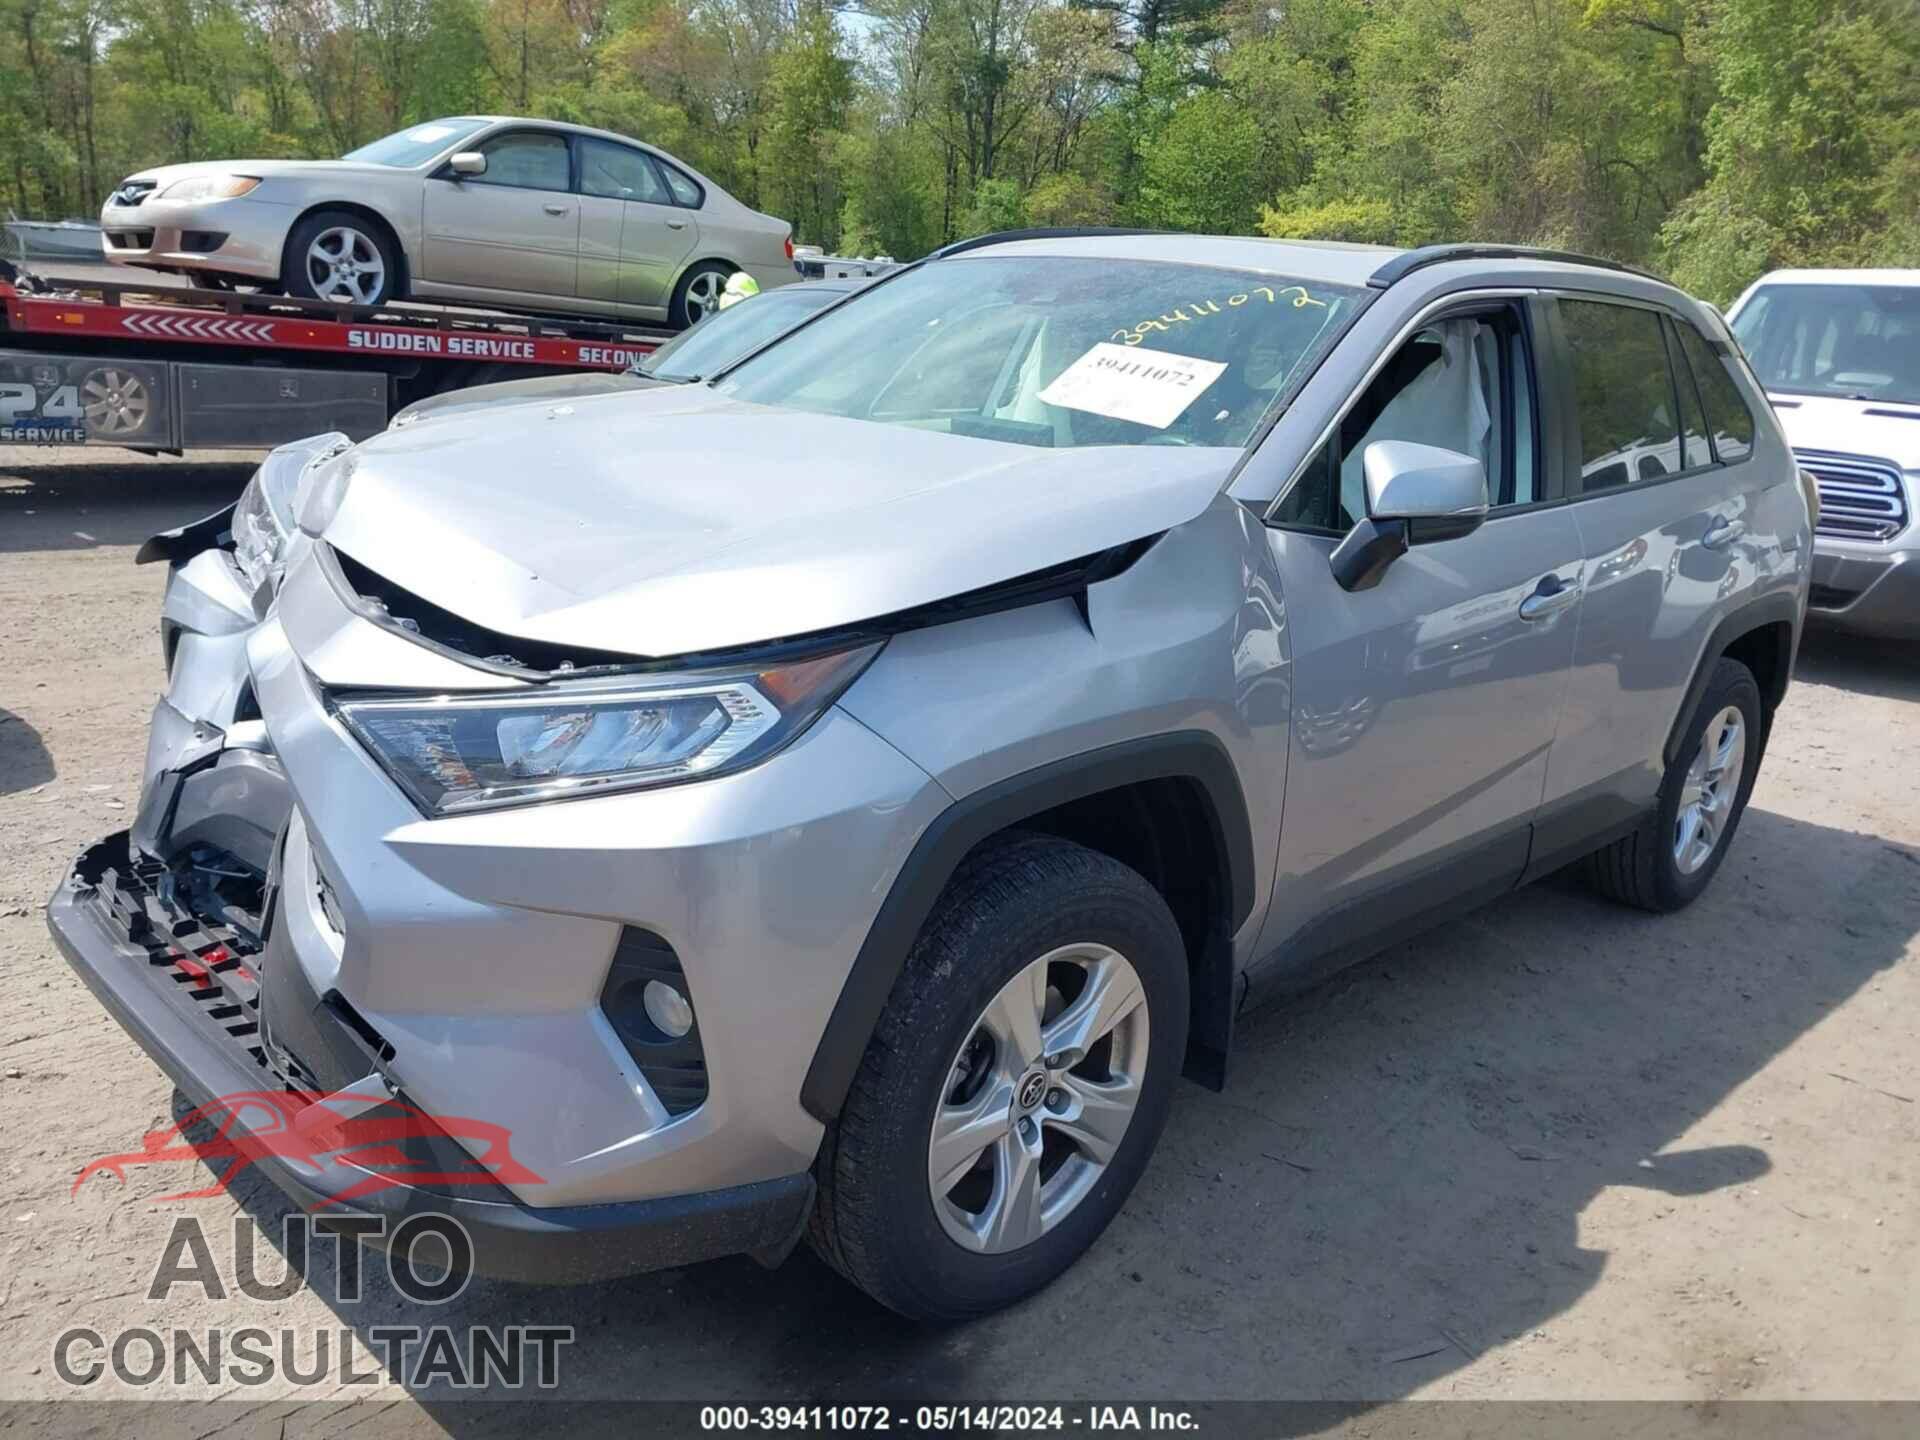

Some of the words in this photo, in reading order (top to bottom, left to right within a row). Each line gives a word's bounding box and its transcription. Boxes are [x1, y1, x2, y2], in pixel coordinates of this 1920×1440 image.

[1111, 286, 1327, 346] 39411072
[347, 329, 441, 352] SUDDEN
[447, 337, 535, 359] SERVICE
[1088, 356, 1196, 387] 39411072
[0, 382, 84, 424] 24
[0, 427, 85, 442] SERVICE
